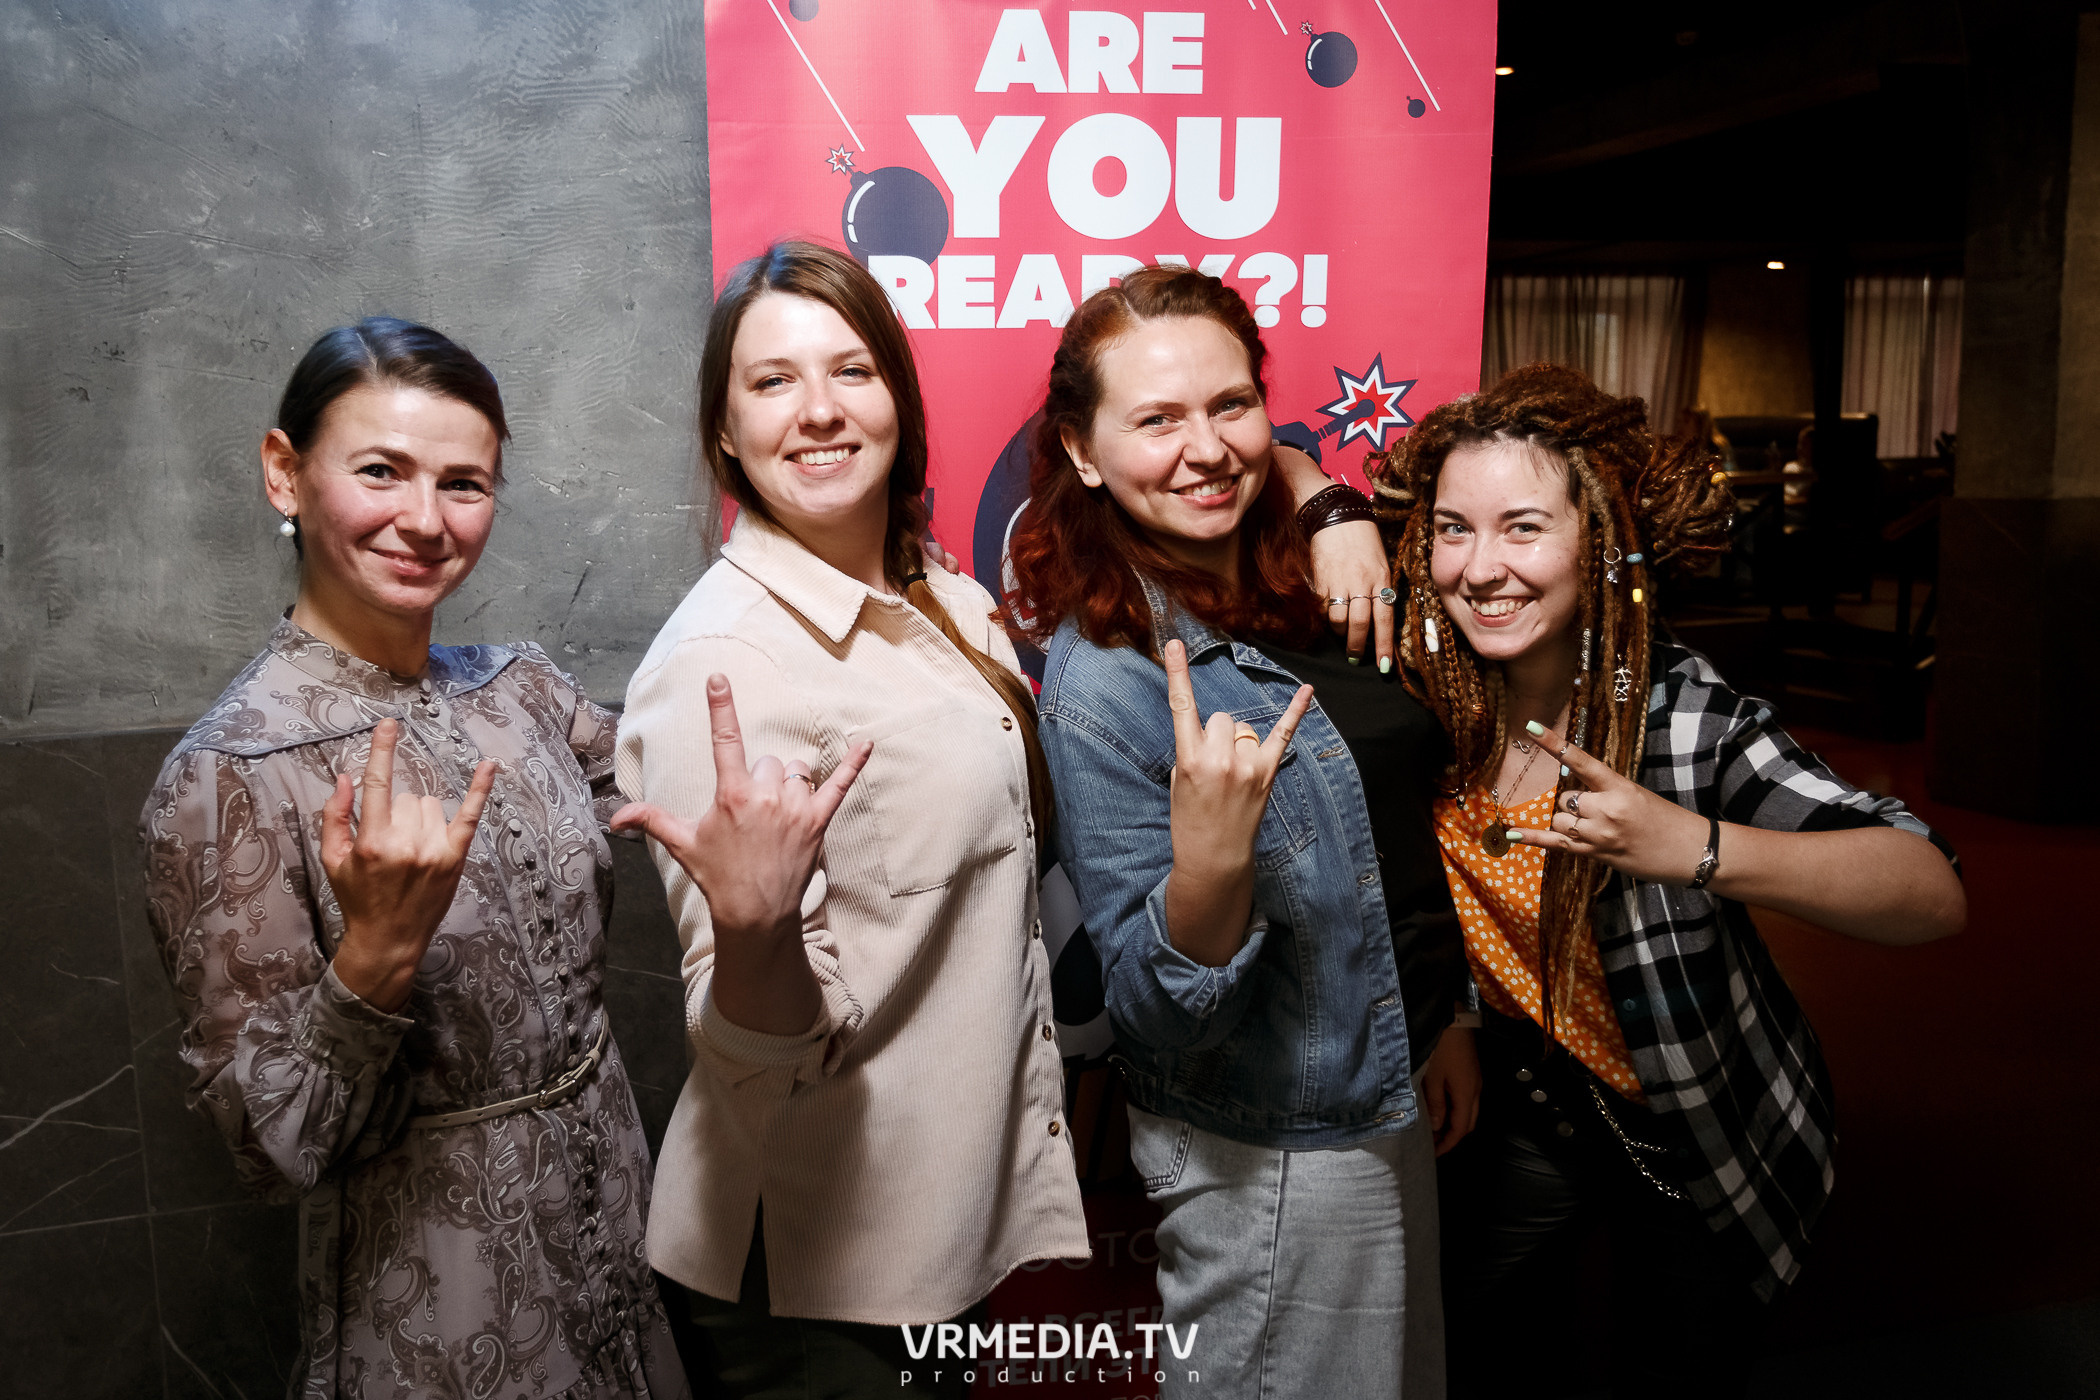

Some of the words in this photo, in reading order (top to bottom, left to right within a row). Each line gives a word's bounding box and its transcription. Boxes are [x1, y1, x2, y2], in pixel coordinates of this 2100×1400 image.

[975, 9, 1204, 94] ARE
[906, 113, 1282, 240] YOU
[867, 252, 1328, 329] REA?!
[970, 1354, 1090, 1388] ТЕЛИ
